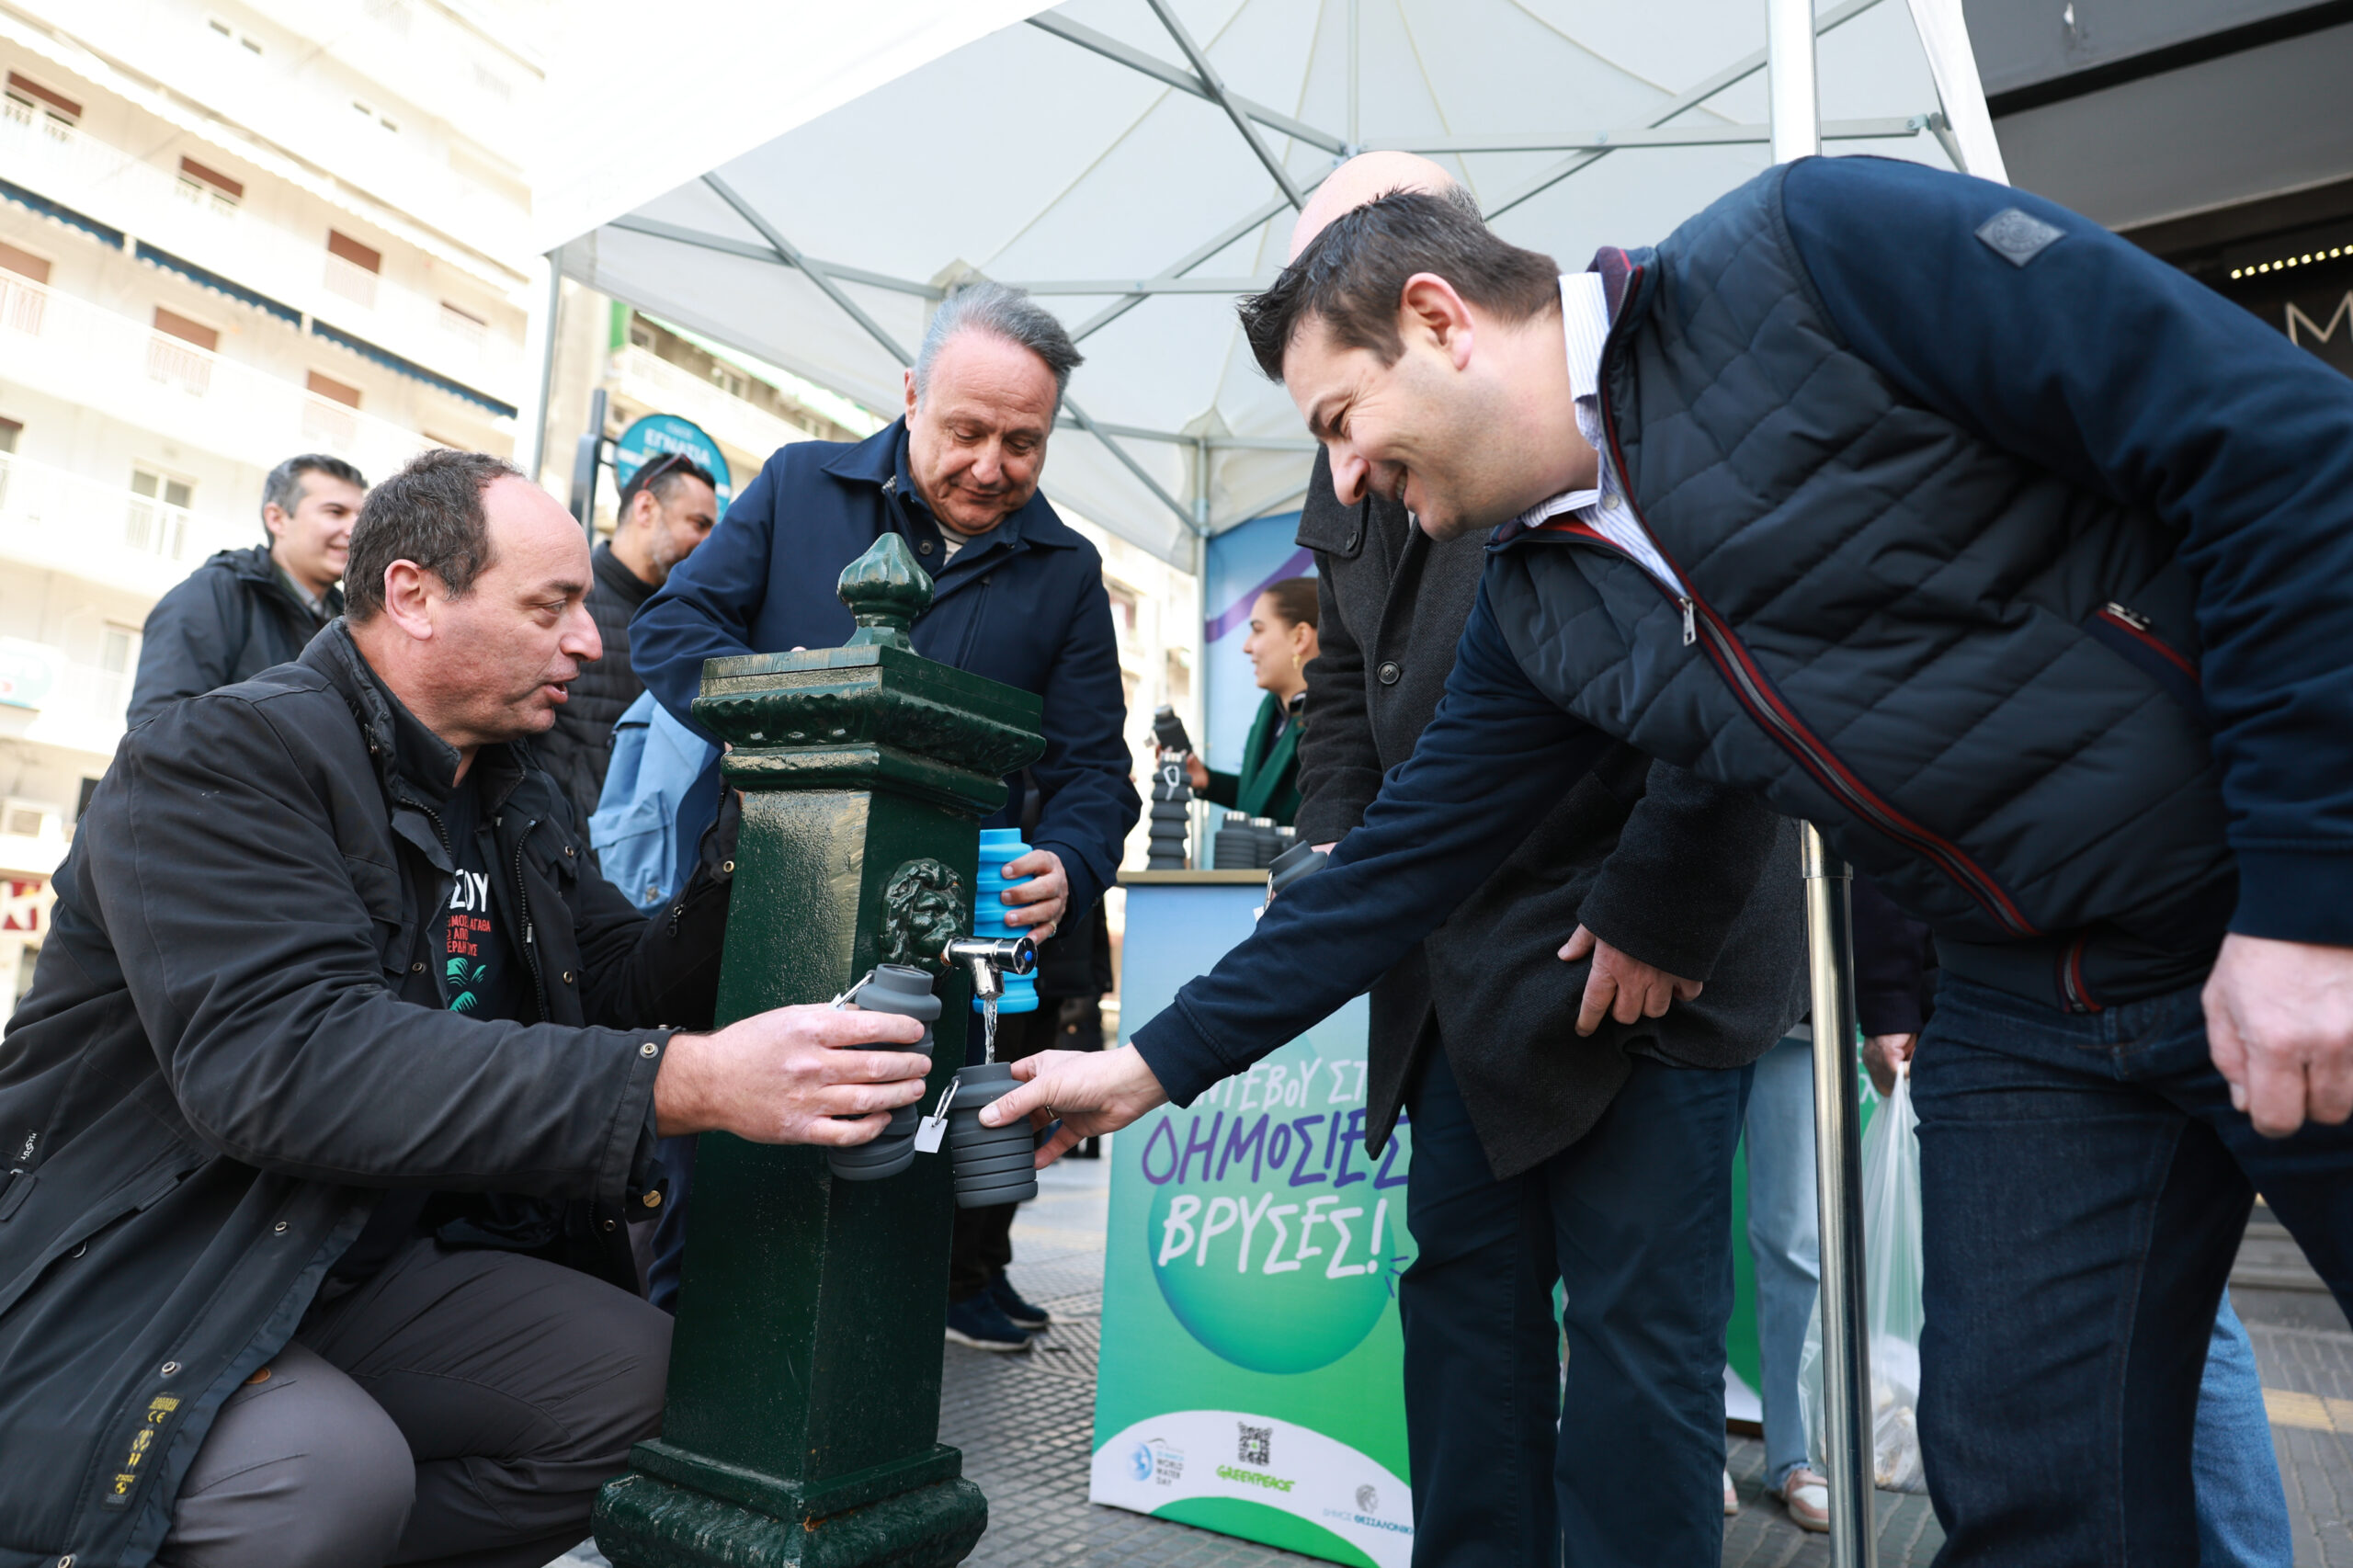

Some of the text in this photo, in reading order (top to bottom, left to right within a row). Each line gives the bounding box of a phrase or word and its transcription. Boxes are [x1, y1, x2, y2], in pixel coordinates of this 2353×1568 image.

[449, 869, 490, 912] ΣΟΥ
[447, 940, 467, 953] ΕΡΔΗ
[1328, 1060, 1369, 1104] ΣΤ
[1157, 1192, 1388, 1278] ΒΡΥΣΕΣ!
[1216, 1464, 1296, 1493] GREENPEACE
